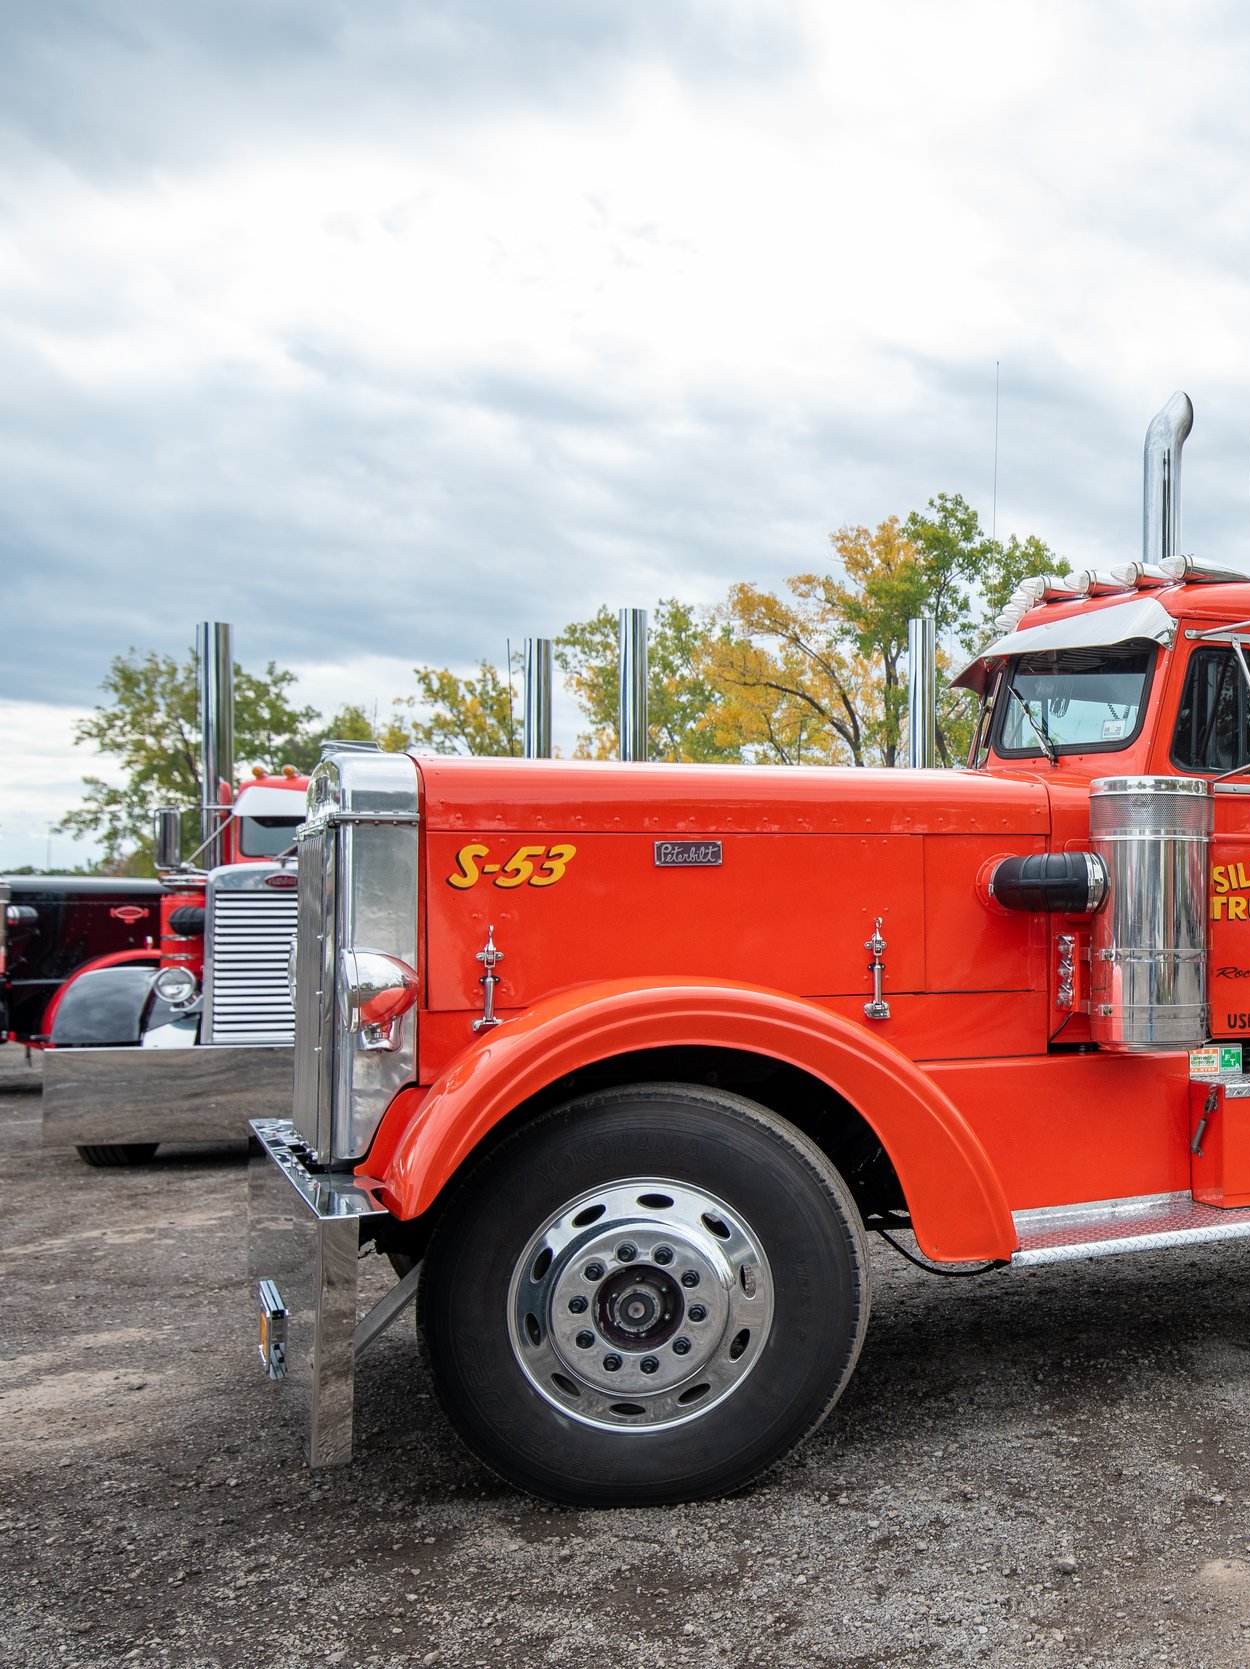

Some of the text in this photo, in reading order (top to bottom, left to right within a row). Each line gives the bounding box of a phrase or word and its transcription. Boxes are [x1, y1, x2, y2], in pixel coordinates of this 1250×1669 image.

[446, 844, 577, 890] S-53
[660, 843, 719, 863] Peterbilt
[533, 1133, 703, 1185] YOKOHAMA
